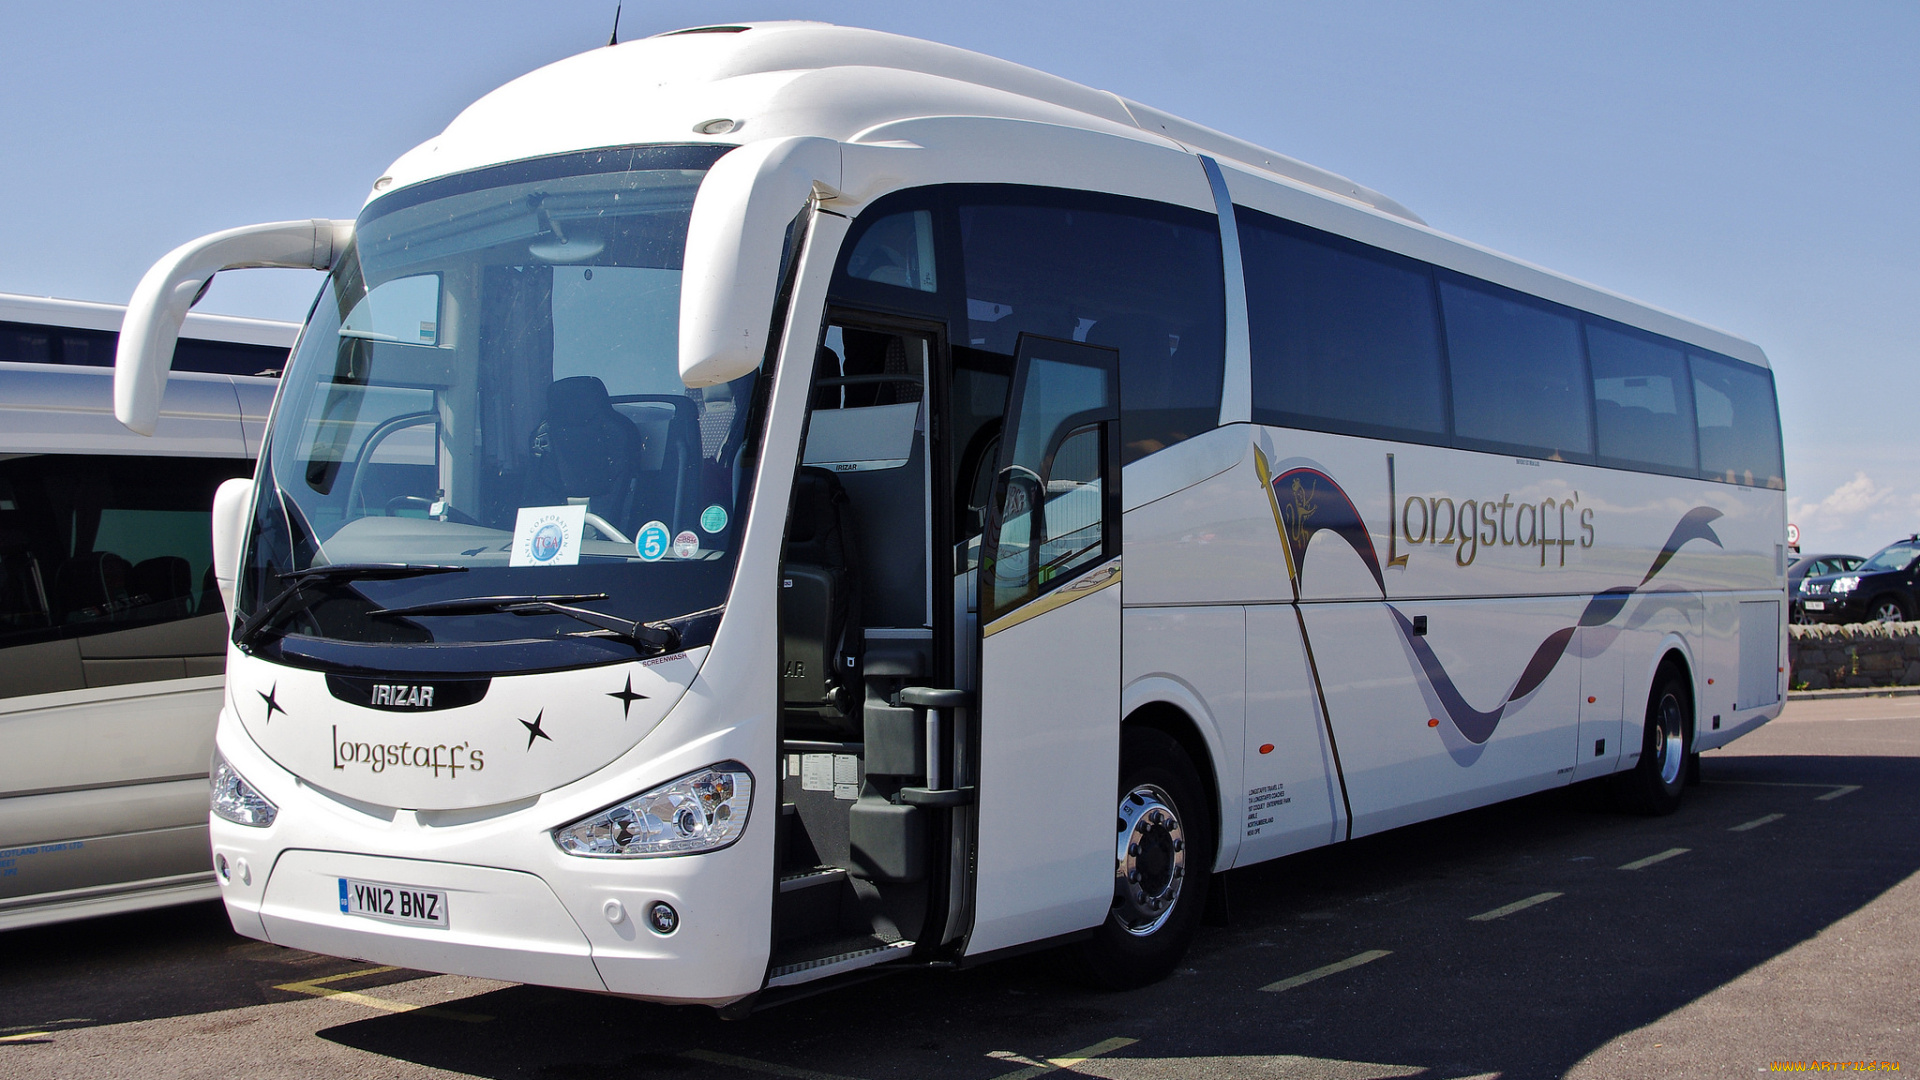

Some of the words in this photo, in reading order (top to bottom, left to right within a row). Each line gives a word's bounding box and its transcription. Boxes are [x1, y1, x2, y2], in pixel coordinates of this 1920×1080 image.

[1385, 453, 1594, 569] Longstaff's
[530, 515, 569, 548] CORPORATION
[535, 536, 559, 549] TCA
[644, 535, 661, 557] 5
[642, 653, 687, 667] SCREENWASH
[371, 684, 434, 707] IRIZAR
[332, 725, 485, 779] Longstaff's
[0, 847, 39, 858] COTLAND
[354, 885, 394, 915] YN12
[400, 891, 439, 920] BNZ
